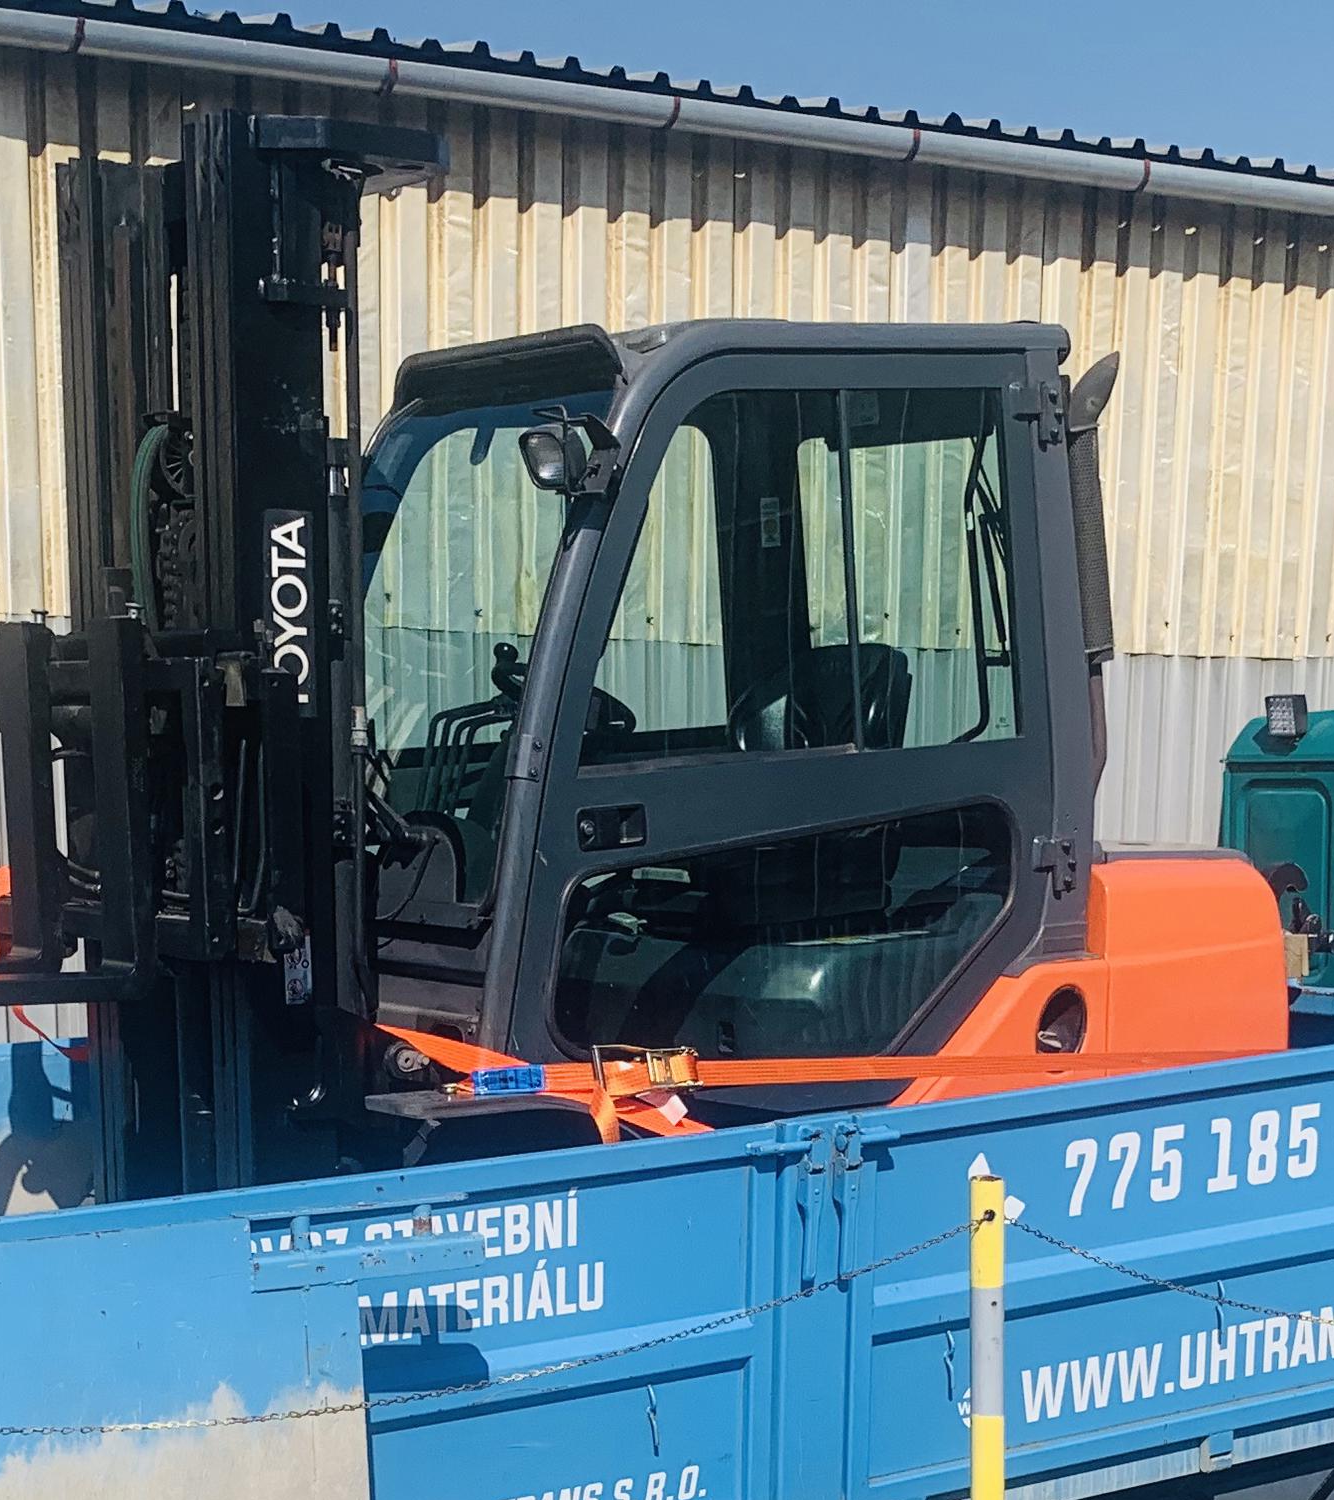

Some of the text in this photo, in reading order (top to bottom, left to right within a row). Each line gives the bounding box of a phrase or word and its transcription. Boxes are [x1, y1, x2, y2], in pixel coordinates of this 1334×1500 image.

[270, 517, 310, 704] OYOTA
[1065, 1123, 1185, 1217] 775
[1207, 1101, 1321, 1194] 185
[357, 1258, 604, 1346] MATERIÁLU
